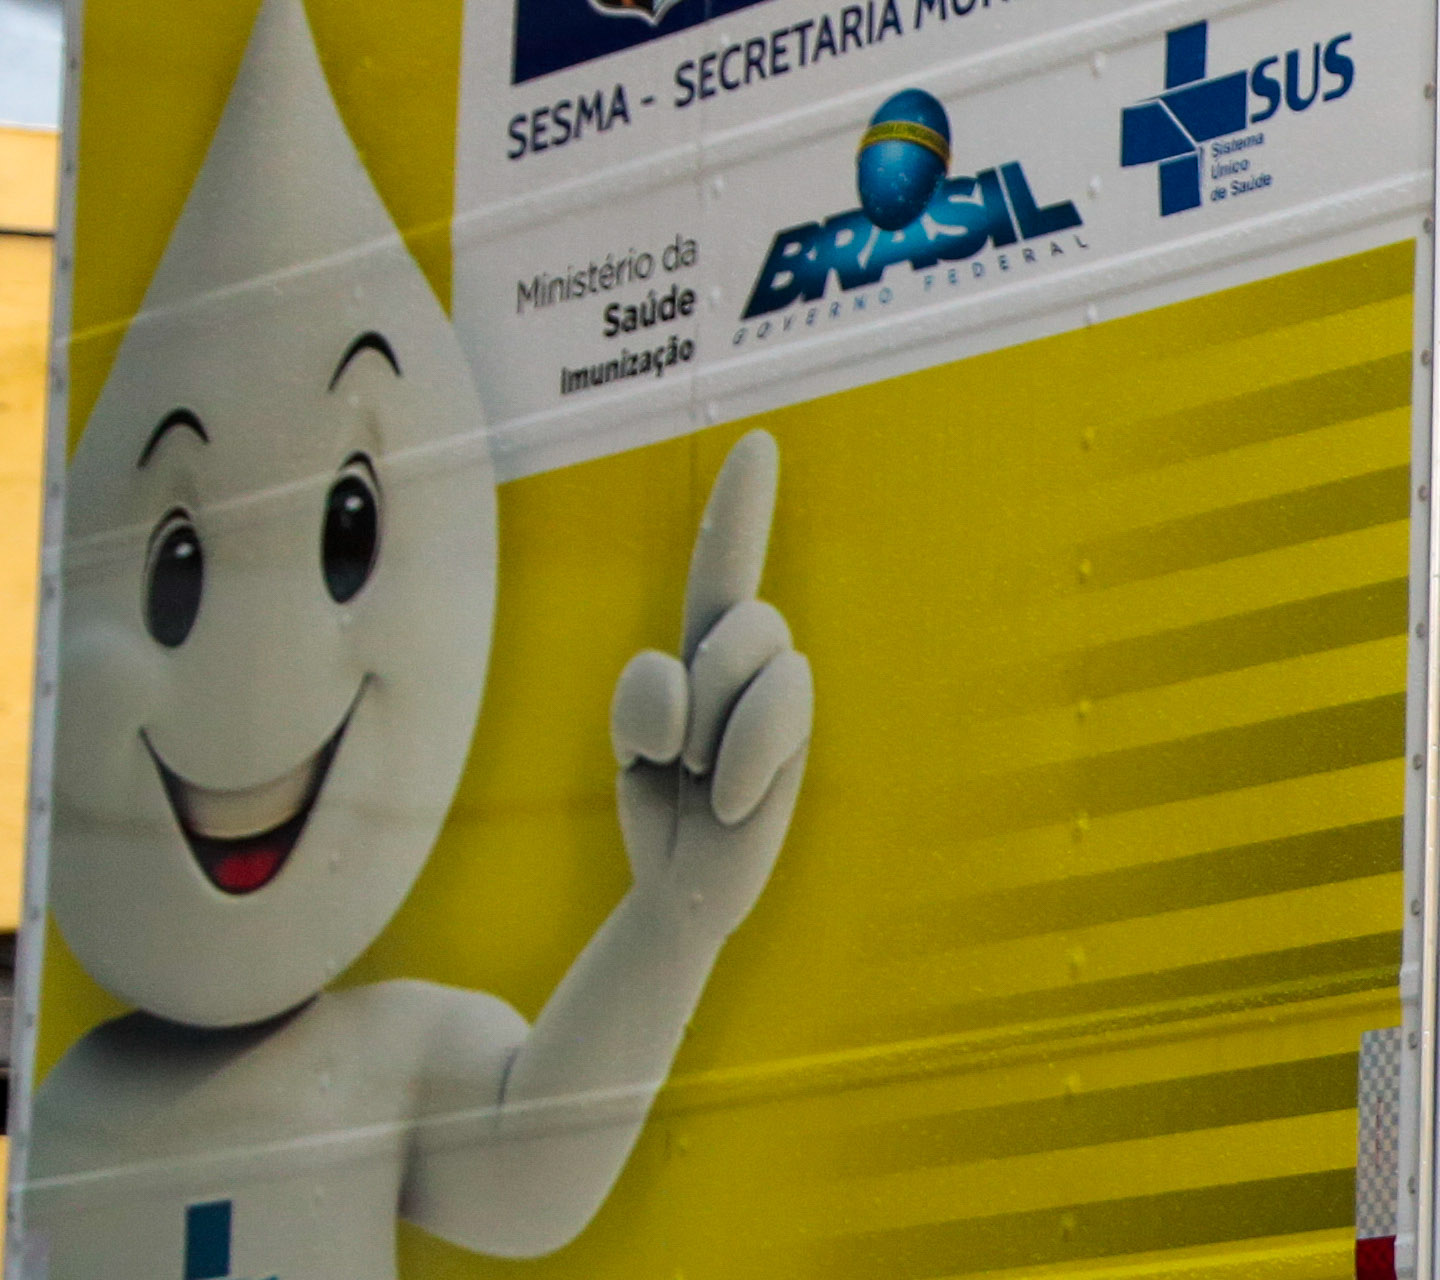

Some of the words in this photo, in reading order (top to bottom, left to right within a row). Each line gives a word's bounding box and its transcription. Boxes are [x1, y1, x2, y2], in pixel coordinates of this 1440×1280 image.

[1251, 33, 1354, 123] SUS
[507, 88, 630, 161] SESMA
[1212, 133, 1264, 157] Sistema
[1211, 159, 1248, 179] Único
[1211, 186, 1227, 201] de
[1231, 173, 1272, 196] Saúde
[516, 240, 652, 313] Ministério
[662, 234, 698, 271] da
[740, 161, 1083, 320] BRASIL
[604, 283, 696, 335] Saúde
[733, 288, 893, 345] GOVERNO
[924, 235, 1089, 291] FEDERAL
[561, 335, 695, 395] Imunização
